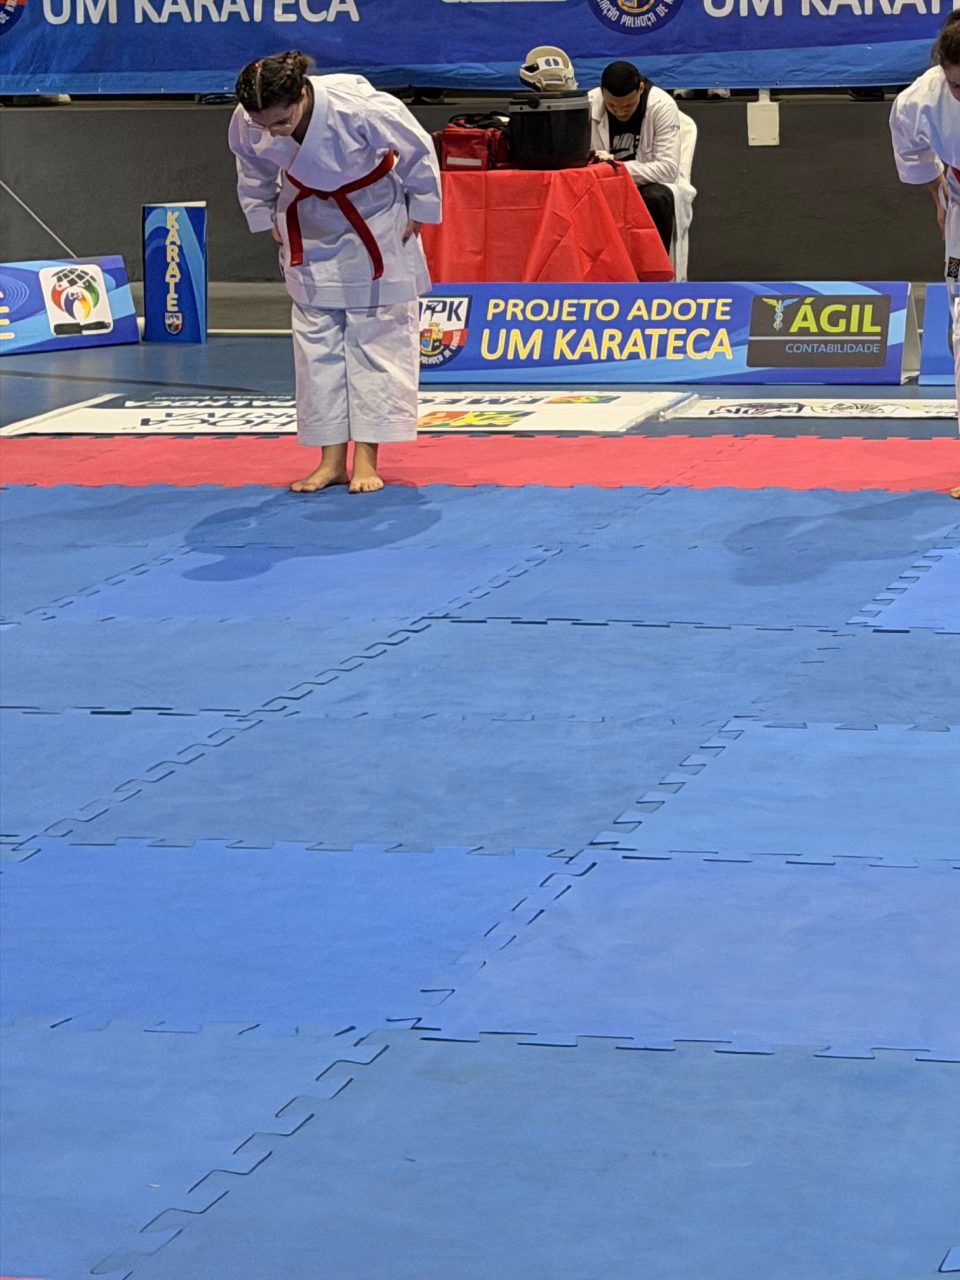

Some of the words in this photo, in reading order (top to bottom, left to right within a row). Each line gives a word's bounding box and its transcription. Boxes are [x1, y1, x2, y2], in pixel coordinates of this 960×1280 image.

[165, 211, 181, 312] KARATE
[486, 298, 621, 321] PROJETO
[627, 298, 733, 321] ADOTE
[789, 297, 882, 333] ÁGIL
[480, 328, 544, 361] UM
[553, 327, 733, 361] KARATECA
[785, 343, 880, 353] CONTABILIDADE
